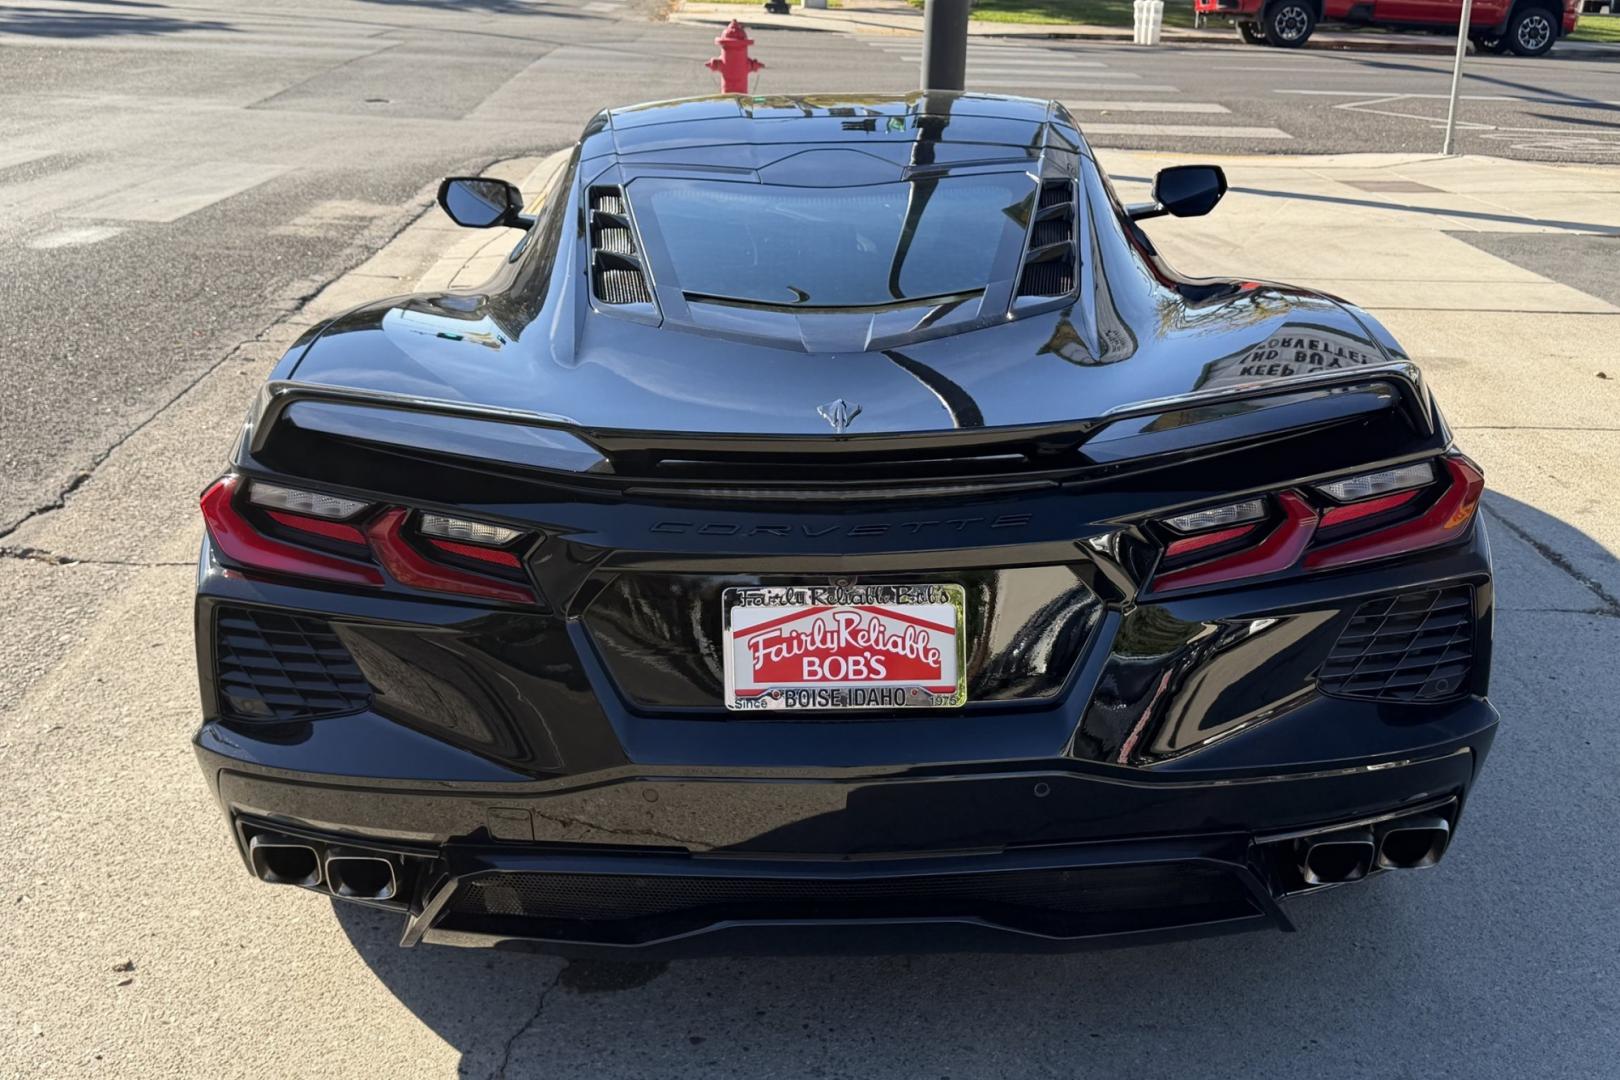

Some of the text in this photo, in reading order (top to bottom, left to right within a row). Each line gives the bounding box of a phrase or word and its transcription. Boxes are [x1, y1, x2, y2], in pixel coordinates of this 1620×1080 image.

[650, 512, 1033, 538] CORVETTE
[748, 610, 942, 670] Fairly Reliable
[802, 652, 887, 680] BOB'S
[734, 698, 768, 709] Since
[850, 687, 907, 707] IDAHO
